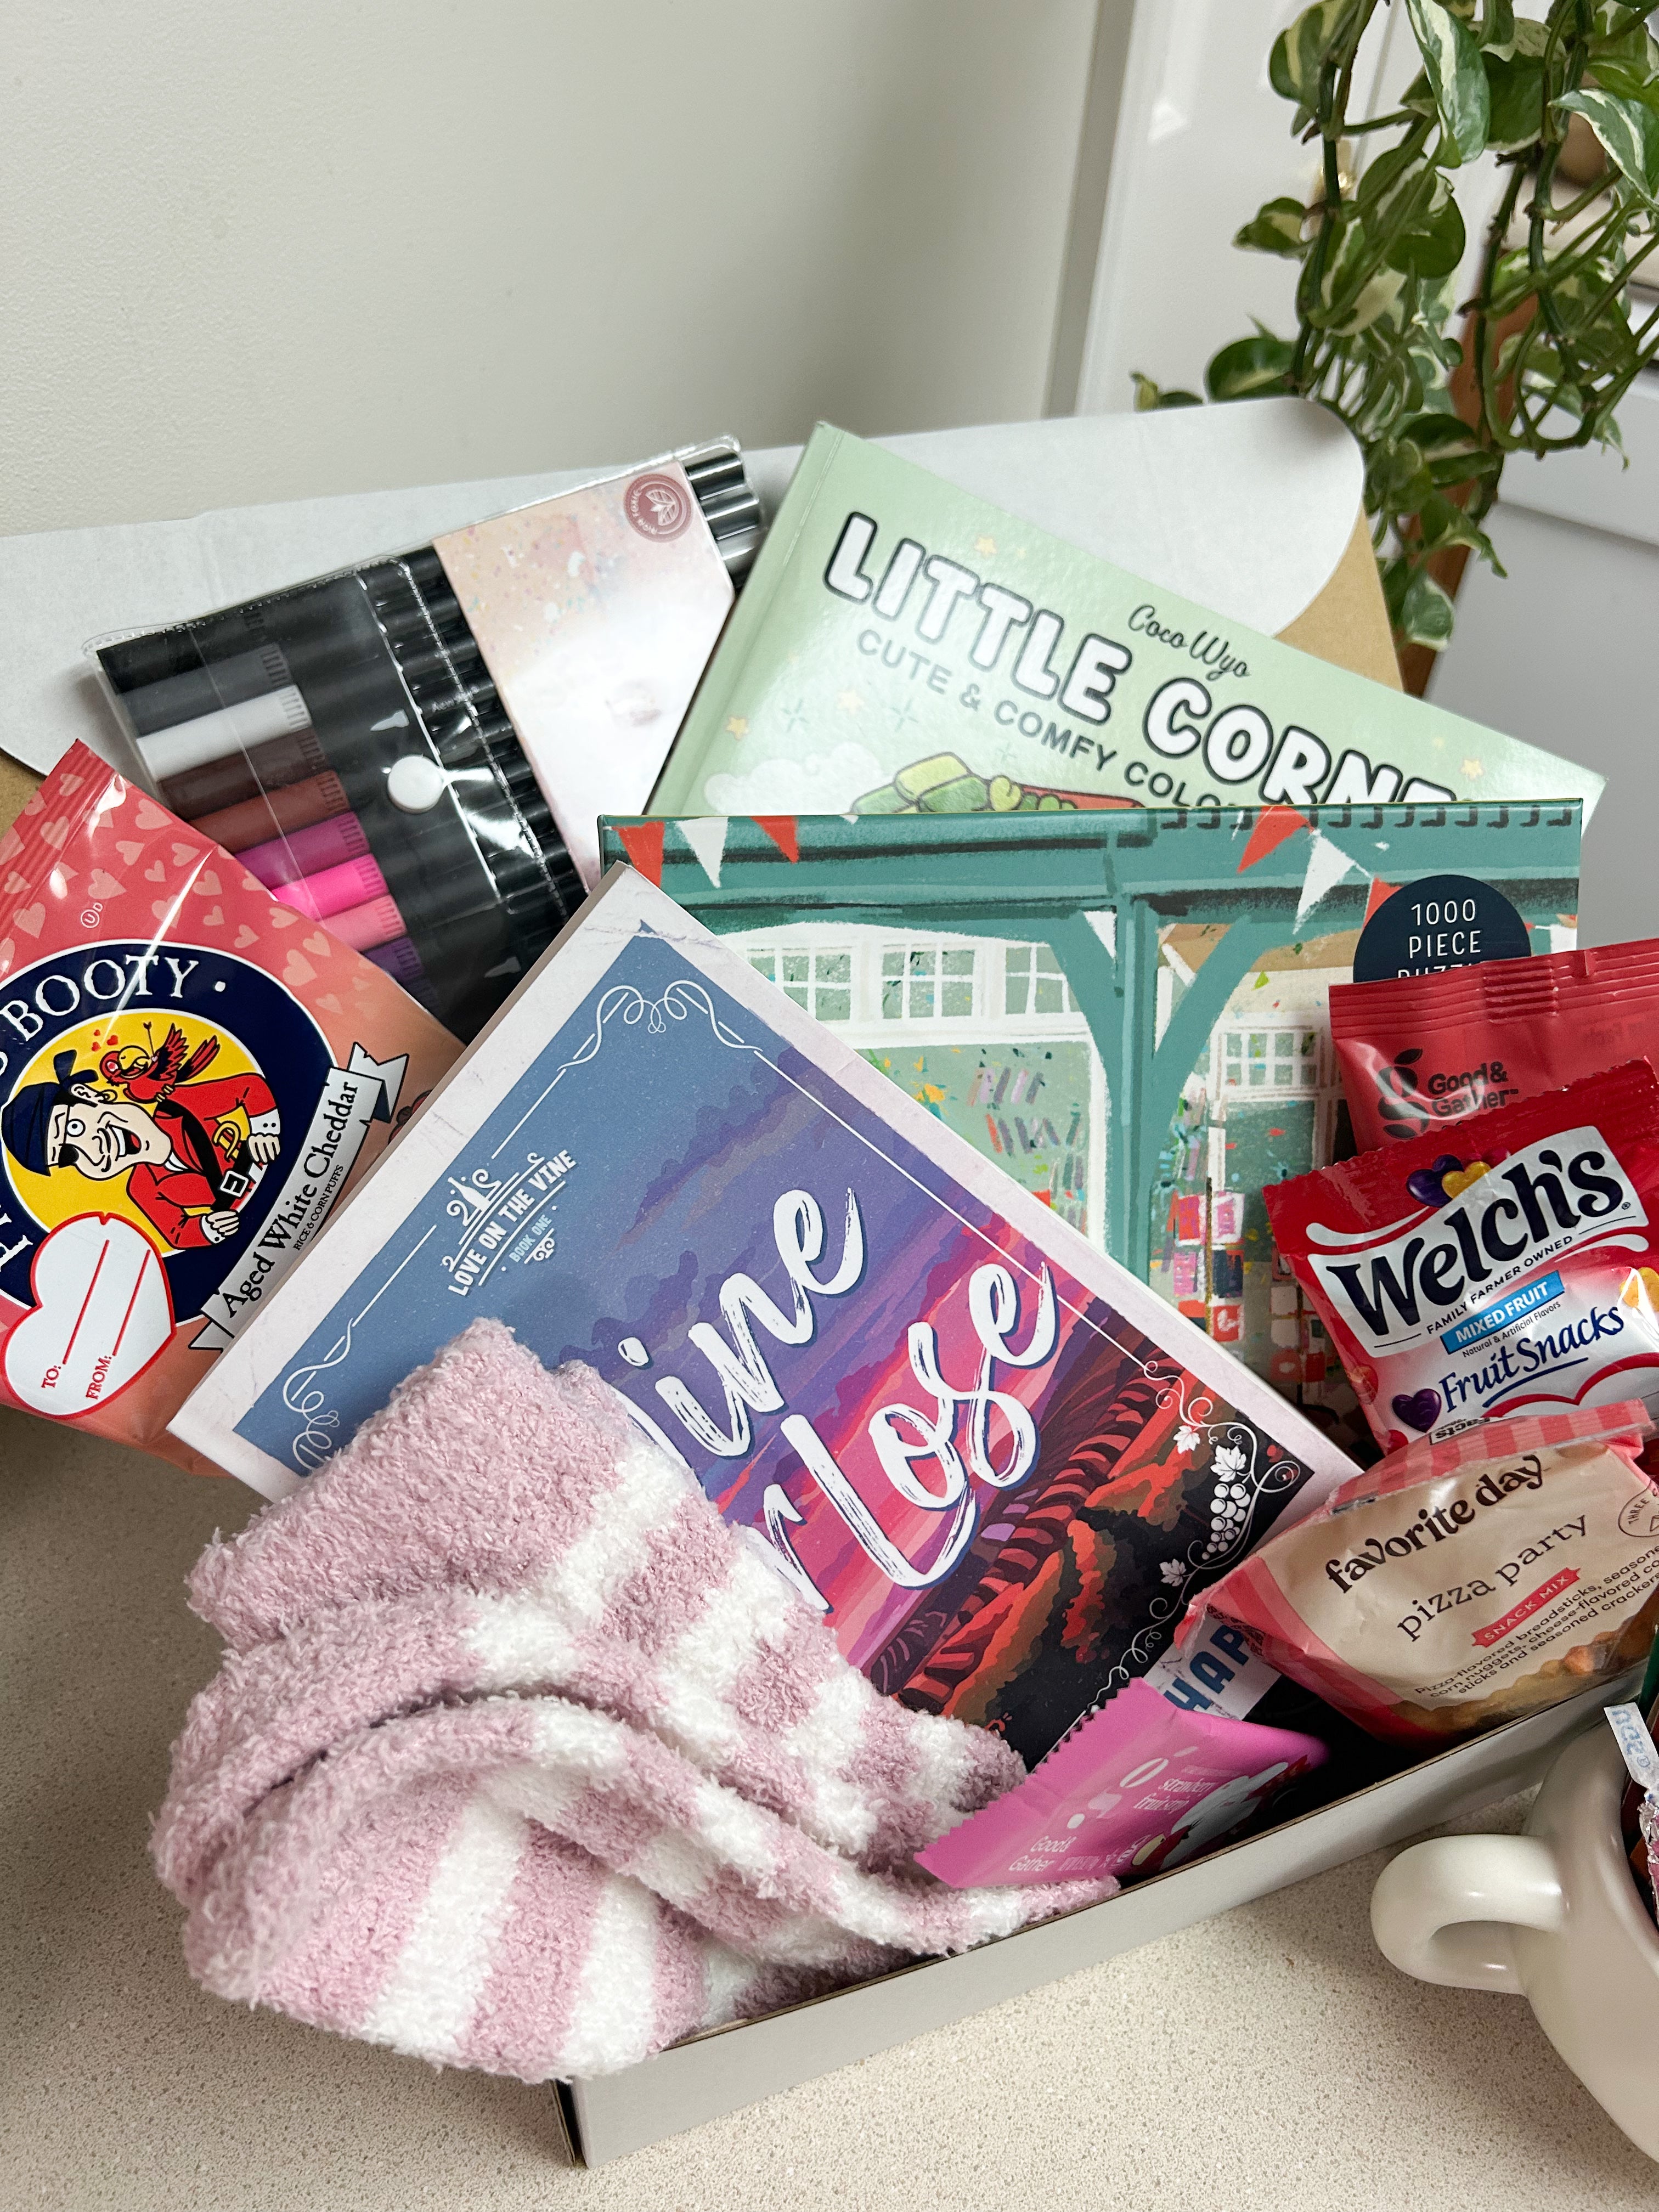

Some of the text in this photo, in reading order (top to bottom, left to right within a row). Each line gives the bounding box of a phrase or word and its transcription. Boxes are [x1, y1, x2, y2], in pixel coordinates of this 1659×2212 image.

[823, 511, 1457, 804] LITTLE CORN
[1128, 604, 1250, 681] Coco Wyo
[857, 629, 953, 695] CUTE
[959, 684, 981, 712] &
[994, 699, 1117, 772] COMFY
[1408, 930, 1482, 959] PIECE
[1410, 899, 1476, 926] 1000
[0, 954, 199, 1042] BOOTY
[222, 1081, 359, 1318] Aged White Cheddar
[293, 1228, 311, 1251] RICE
[311, 1193, 330, 1221] CORN
[325, 1164, 344, 1194] PUFFS
[448, 1149, 577, 1296] LOVE ON THE VINE
[509, 1214, 552, 1263] BOOK ONE
[1325, 1149, 1624, 1337] Welch's
[1426, 1235, 1573, 1335] FAMILY FARMER OWNED
[1454, 1281, 1549, 1344] MIXED FRUIT
[1437, 1304, 1625, 1413] Fruit Snacks
[1462, 1301, 1561, 1358] Natural & Artificial Flavors
[41, 1364, 61, 1389] TO:
[85, 1355, 112, 1400] FROM:
[780, 1260, 1059, 1589] Lose
[1325, 1454, 1545, 1594] favorite day
[1627, 1498, 1650, 1525] THREE
[1397, 1514, 1587, 1642] pizza party
[1484, 1575, 1570, 1641] SNACK MIX
[1516, 1583, 1602, 1641] breadsticks,
[1430, 1681, 1463, 1697] corn
[1528, 1571, 1641, 1644] cheese-flavored
[1458, 1669, 1498, 1694] sticks
[1499, 1650, 1528, 1669] and
[1530, 1607, 1599, 1651] seasoned
